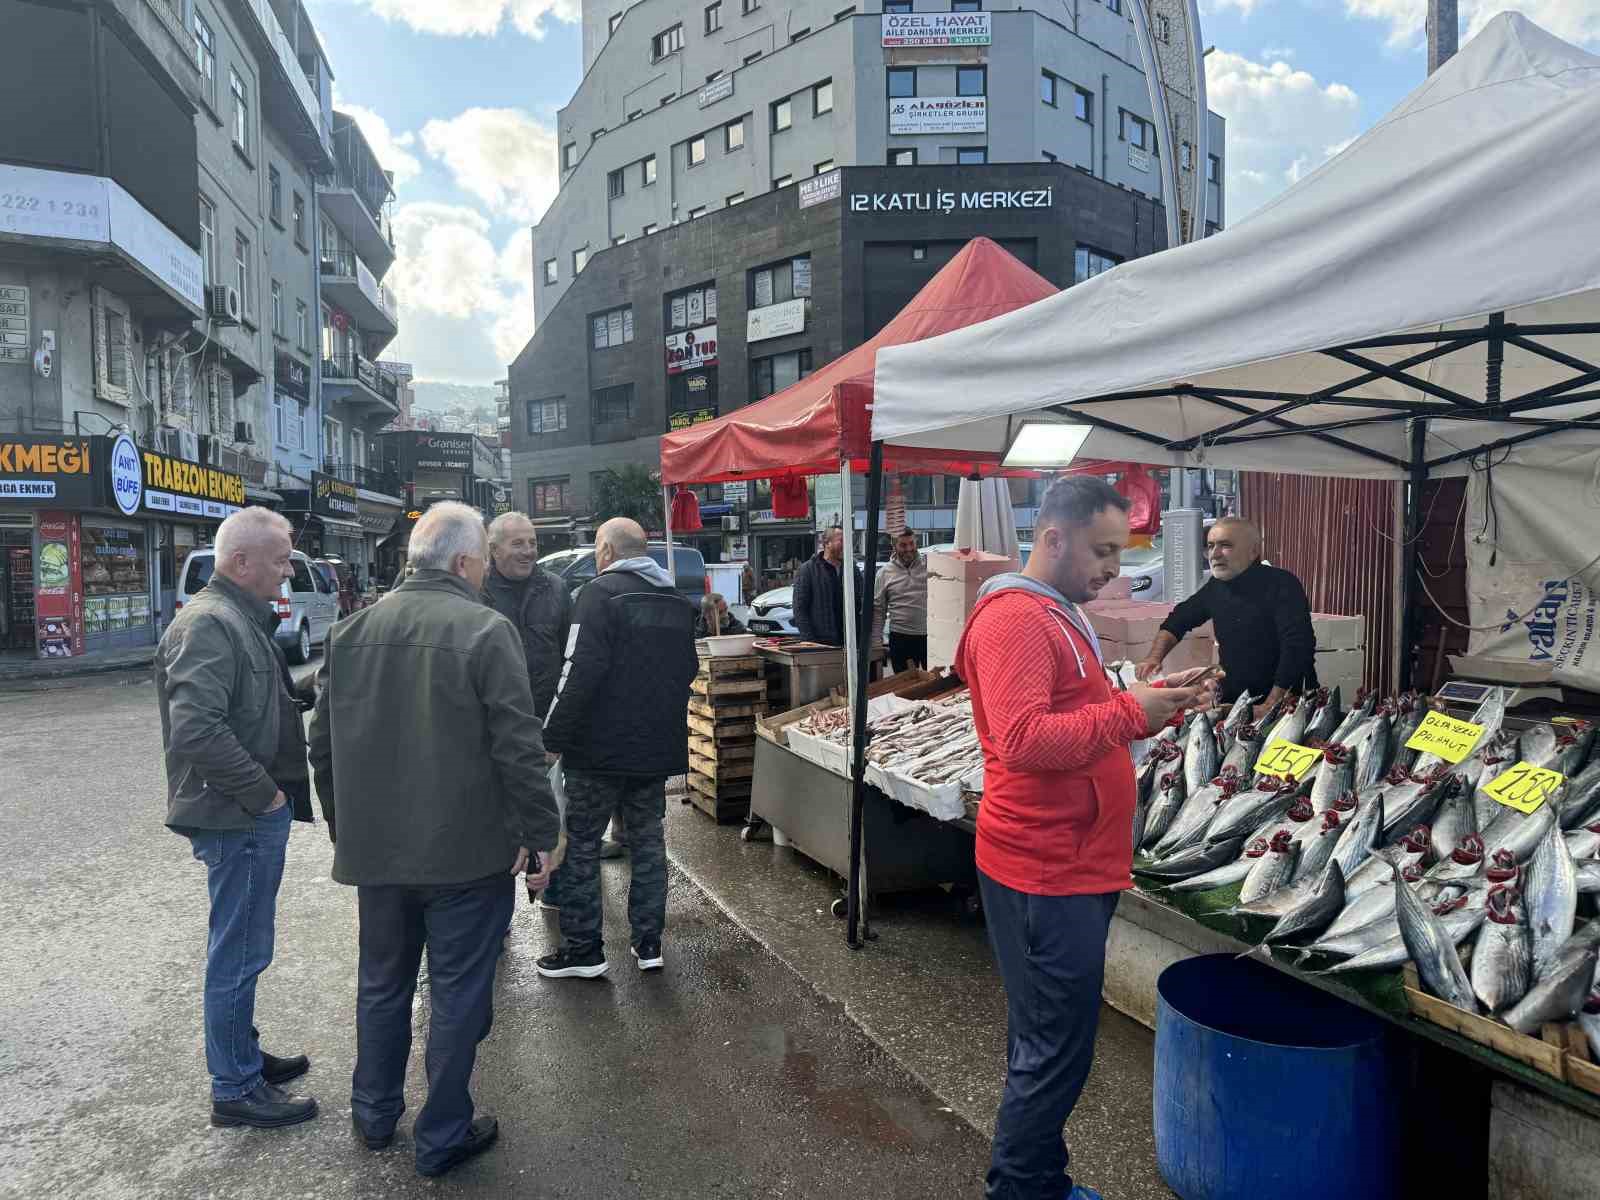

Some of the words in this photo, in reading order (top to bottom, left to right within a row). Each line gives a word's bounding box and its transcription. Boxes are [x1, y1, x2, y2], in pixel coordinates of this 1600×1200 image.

[888, 16, 931, 28] ÖZEL
[936, 15, 985, 27] HAYAT
[949, 24, 988, 36] MERKEZİ
[873, 192, 931, 211] KATLI
[936, 188, 955, 214] İŞ
[961, 185, 1053, 210] MERKEZİ
[118, 454, 136, 472] ANIT
[19, 483, 55, 495] EKMEK
[116, 475, 139, 495] BÜFE
[144, 452, 208, 497] TRABZON
[208, 469, 245, 505] EKMEĞİ
[1524, 579, 1568, 660] vatan
[1260, 745, 1314, 776] 150
[1494, 768, 1556, 804] 150
